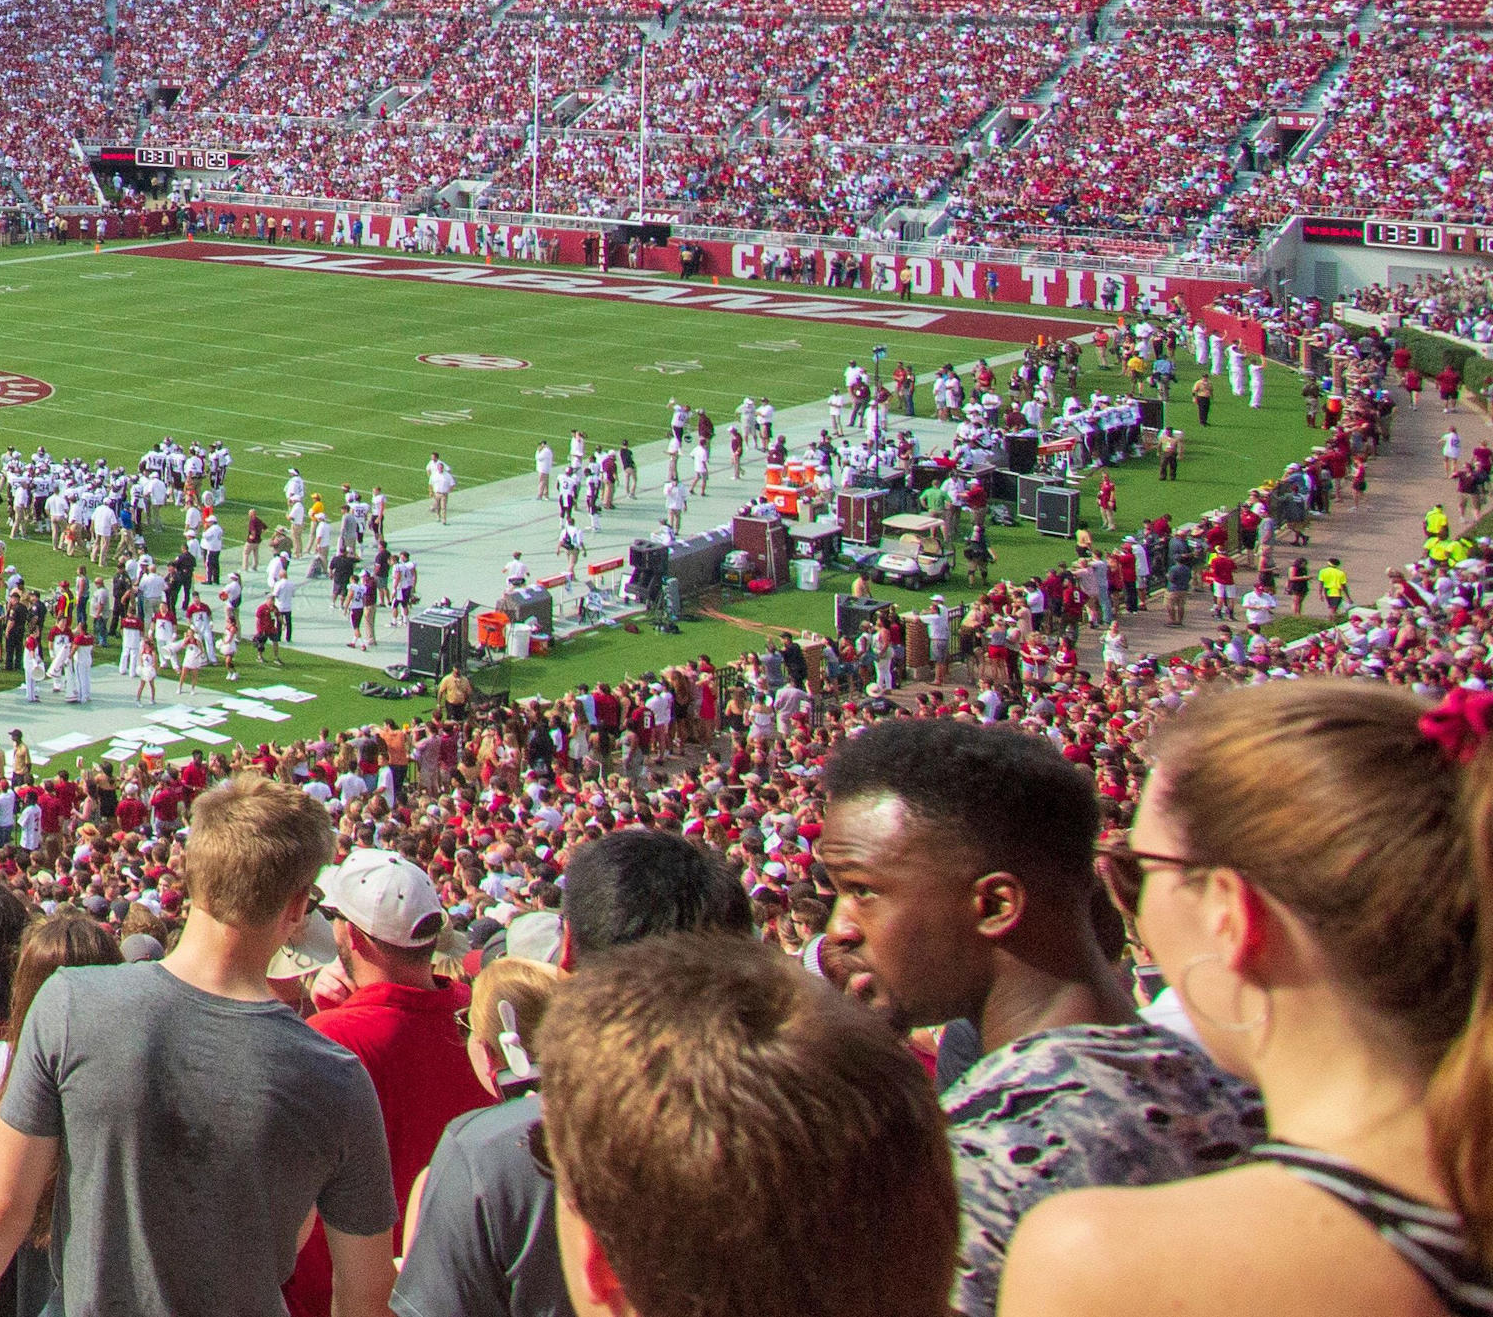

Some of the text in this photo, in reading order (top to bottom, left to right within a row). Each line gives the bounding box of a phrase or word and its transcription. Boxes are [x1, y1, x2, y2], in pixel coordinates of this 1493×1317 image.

[141, 150, 174, 165] 13:31
[192, 156, 204, 167] 10
[208, 154, 225, 167] 25
[627, 211, 680, 224] BAMA
[1377, 225, 1436, 245] 13:31
[202, 253, 947, 329] ALABAMA
[1020, 266, 1168, 316] TIDE
